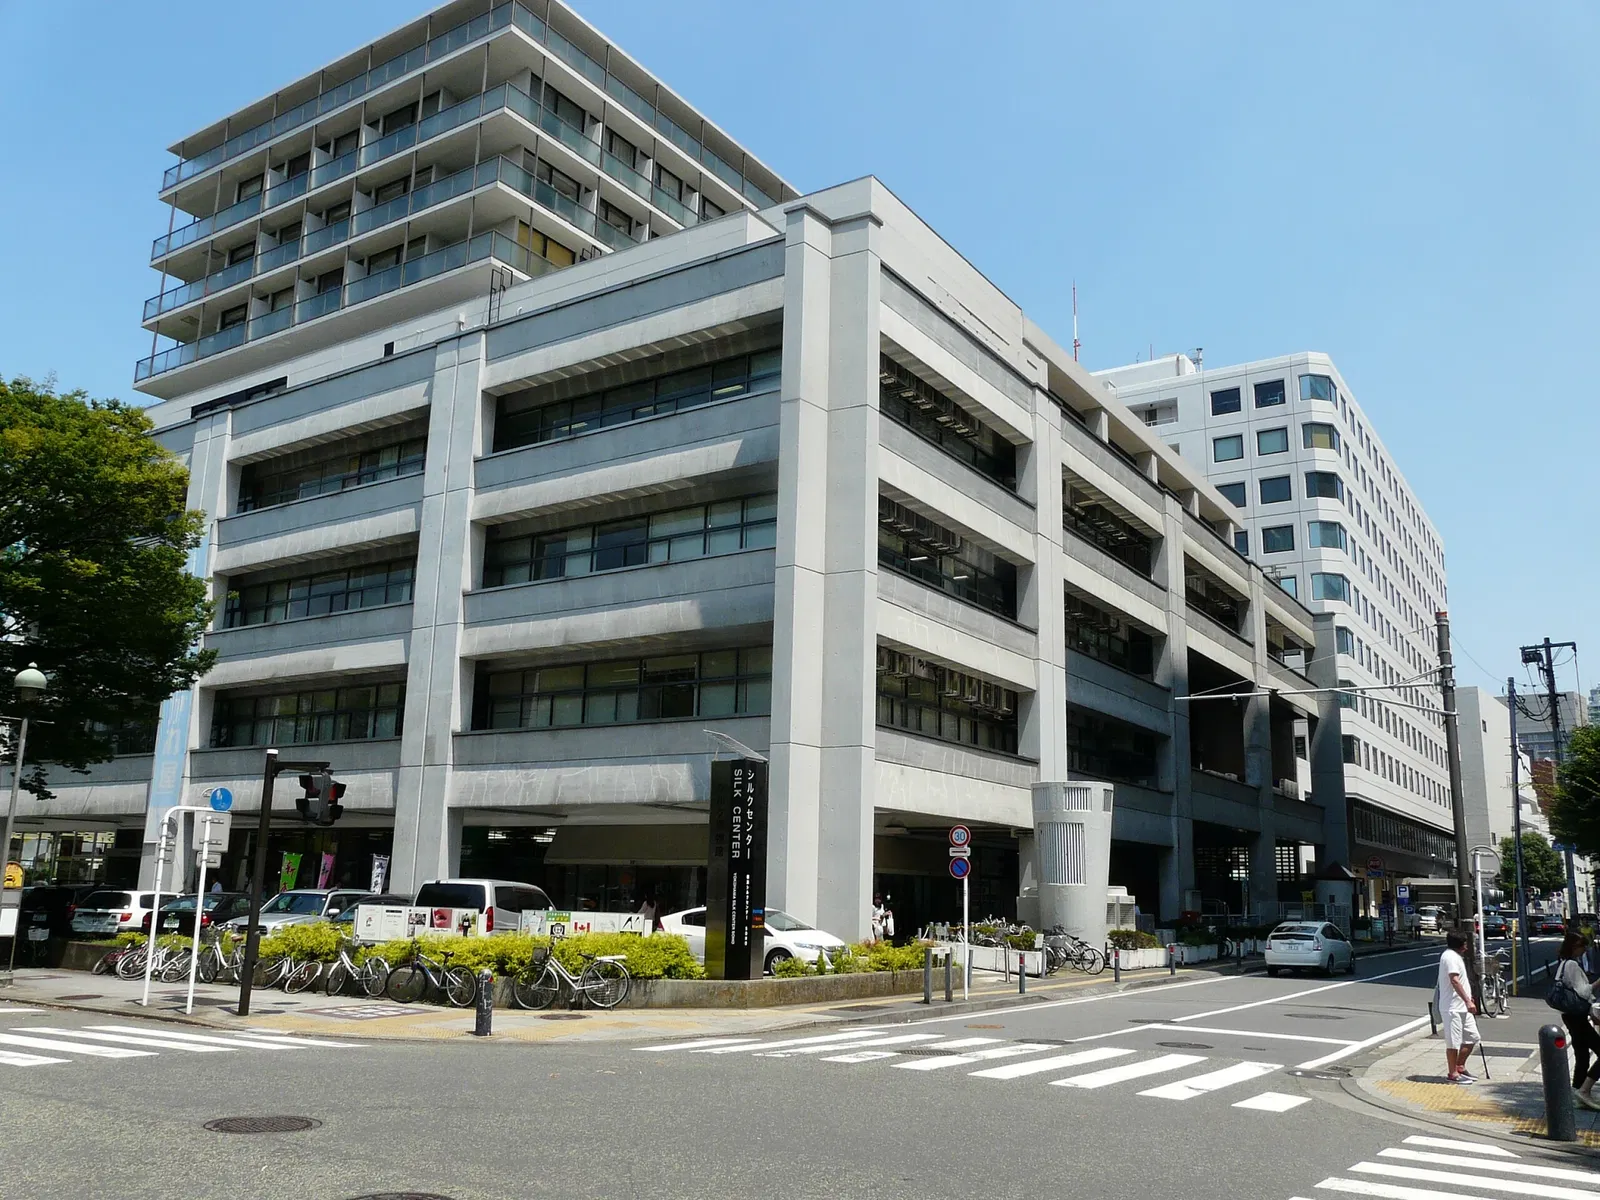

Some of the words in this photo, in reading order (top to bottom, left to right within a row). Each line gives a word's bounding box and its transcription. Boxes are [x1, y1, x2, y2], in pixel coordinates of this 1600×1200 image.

[733, 768, 743, 798] SILK
[732, 806, 742, 859] CENTER
[745, 769, 755, 860] シルクセンター
[954, 831, 966, 841] 30
